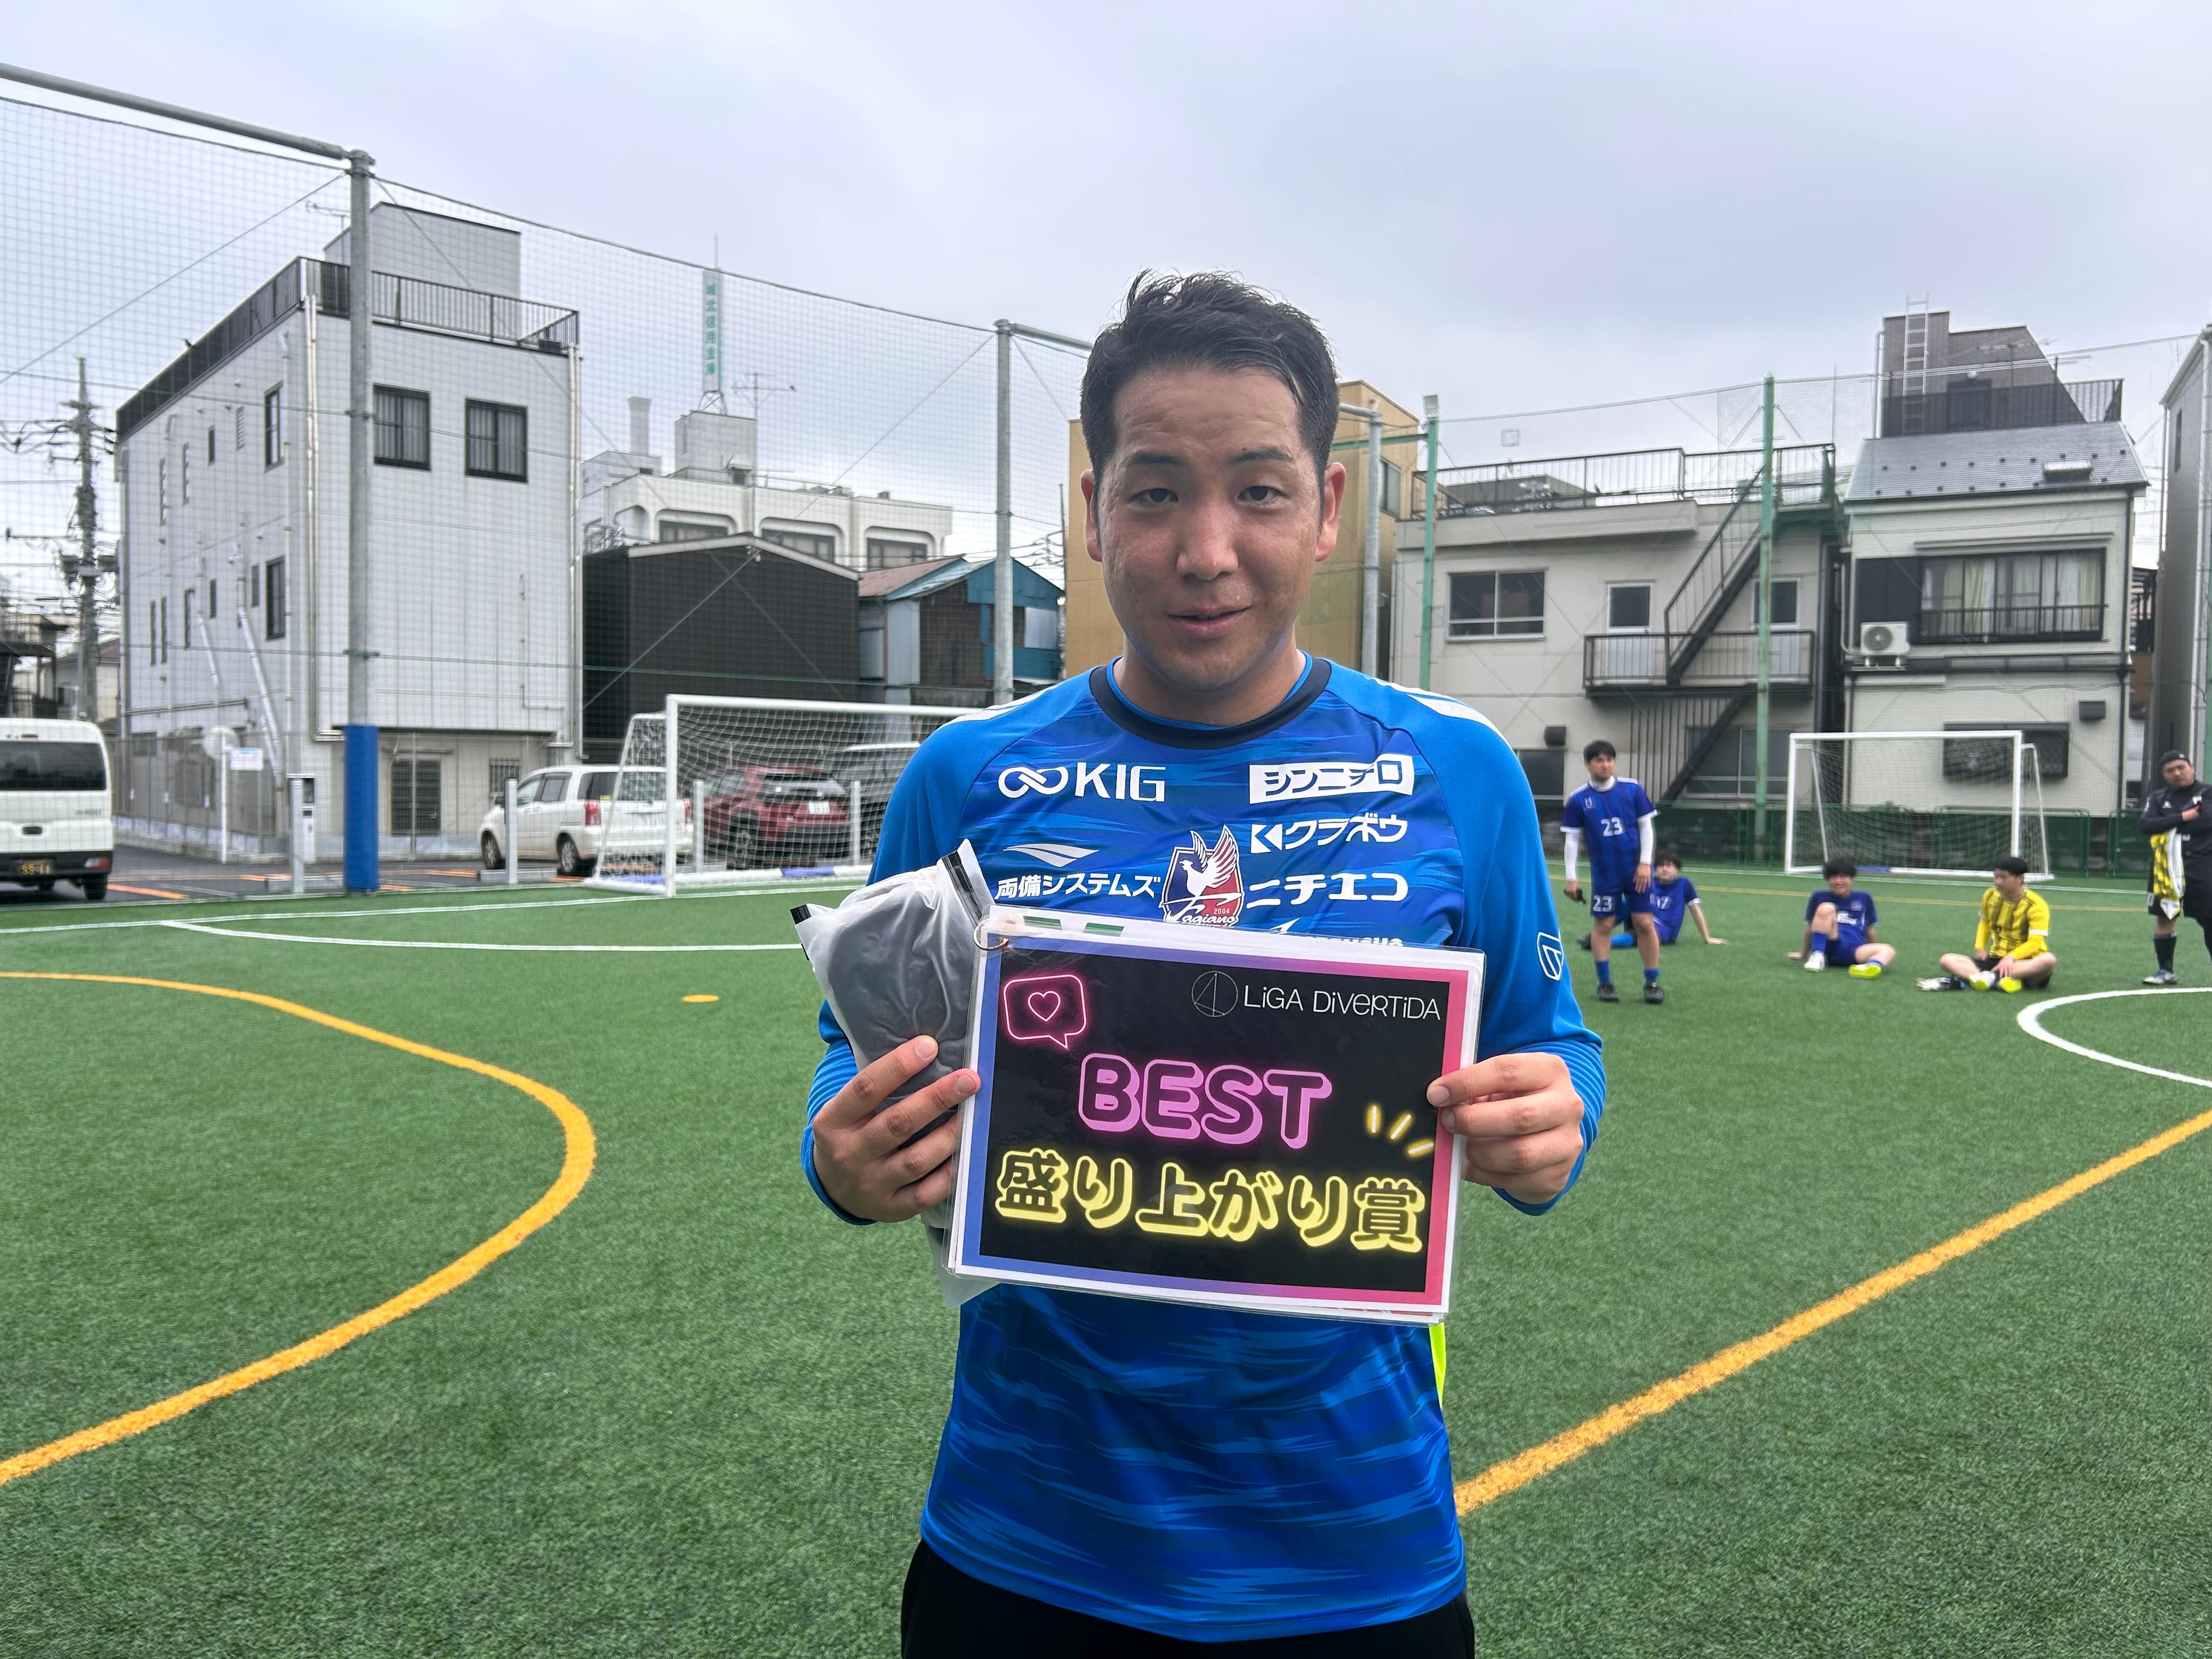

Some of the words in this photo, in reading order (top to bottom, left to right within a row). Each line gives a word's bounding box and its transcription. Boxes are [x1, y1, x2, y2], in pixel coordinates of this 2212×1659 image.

[1264, 760, 1402, 796] シンニチロ
[1285, 813, 1408, 850] クラボウ
[1601, 817, 1623, 836] 23
[995, 873, 1161, 900] 両備システムズ
[1247, 873, 1408, 908] ニチエコ
[1593, 895, 1613, 912] 23
[1078, 1052, 1332, 1150] BEST
[995, 1147, 1426, 1253] 盛り上がり賞
